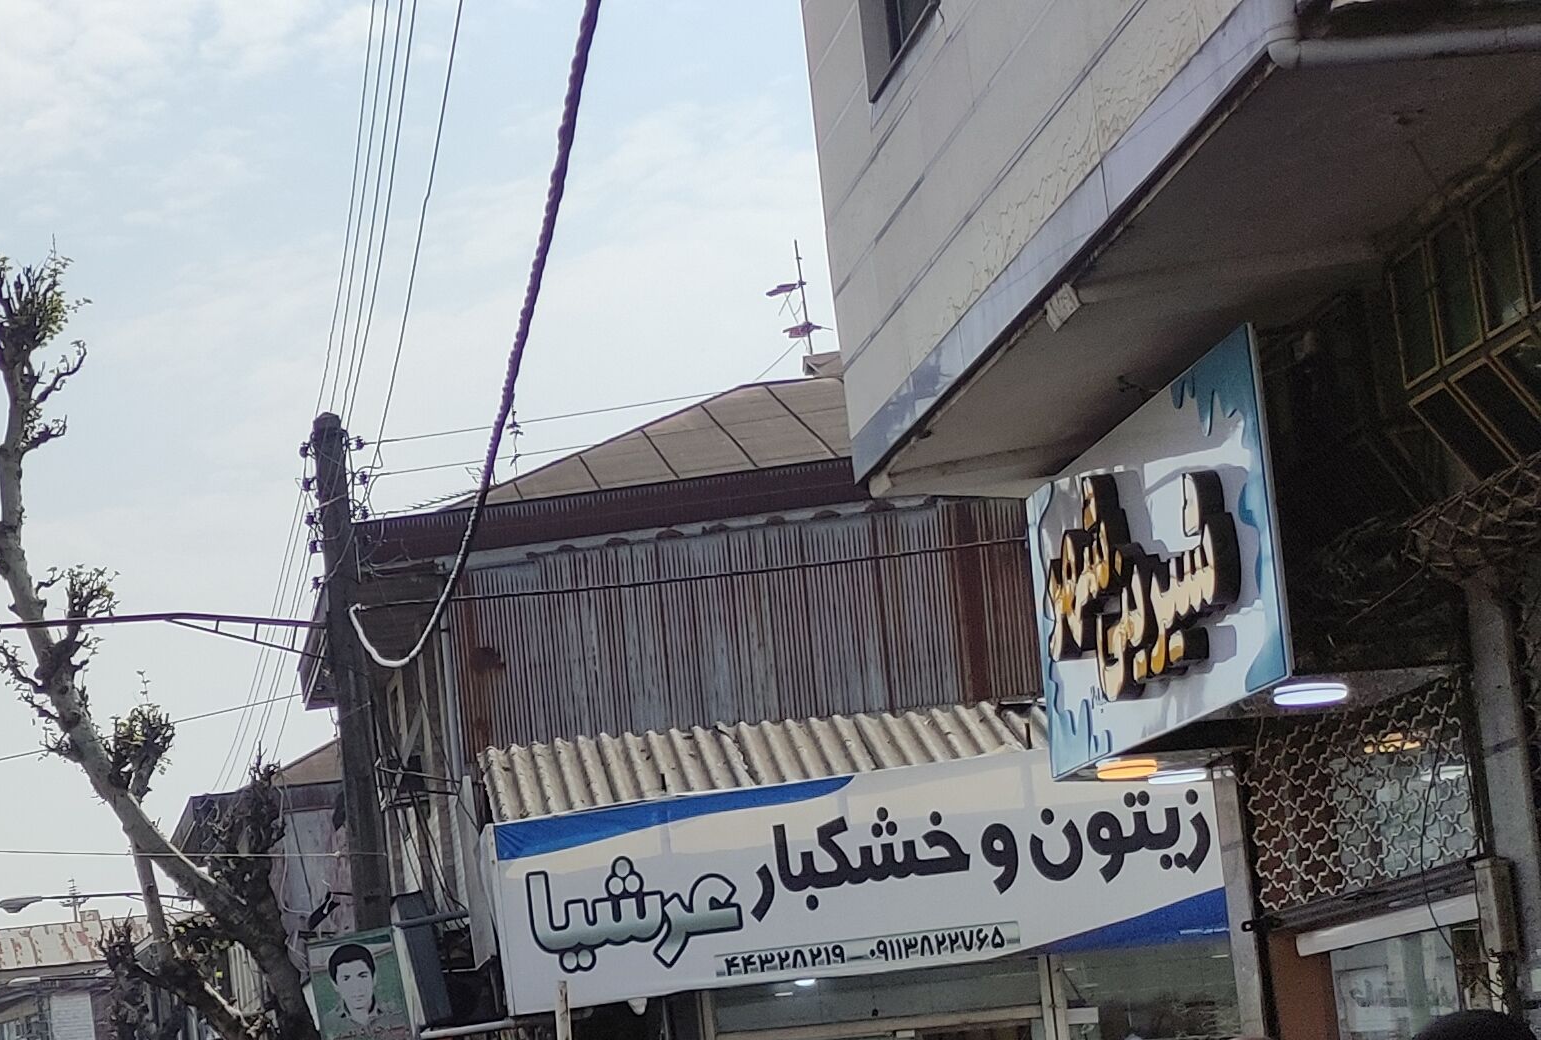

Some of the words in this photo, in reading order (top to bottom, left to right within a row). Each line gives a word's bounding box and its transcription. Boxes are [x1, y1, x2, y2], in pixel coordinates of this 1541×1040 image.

[750, 806, 971, 922] خشکبار
[980, 822, 1019, 895] و
[1030, 788, 1211, 884] زیتون
[525, 856, 744, 973] عرشیا
